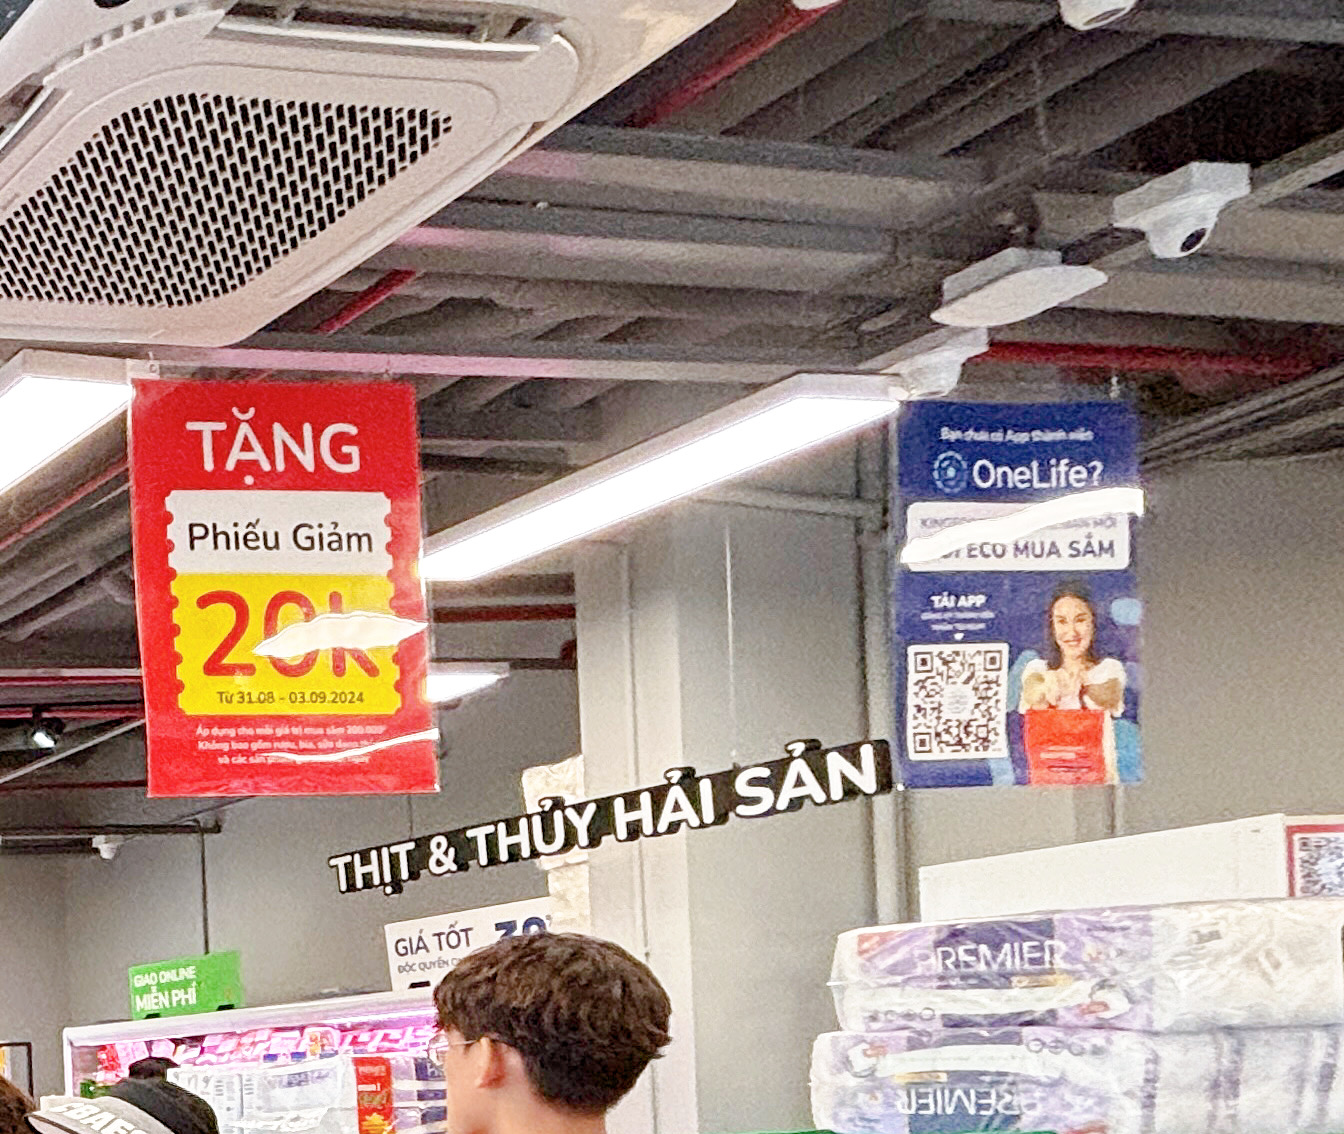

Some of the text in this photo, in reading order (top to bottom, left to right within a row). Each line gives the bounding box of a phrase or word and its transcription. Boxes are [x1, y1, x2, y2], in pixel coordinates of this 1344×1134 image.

[185, 405, 361, 486] TẶNG
[973, 458, 1104, 489] OneLife?
[188, 518, 373, 553] Phiếu Giảm
[966, 532, 1116, 559] ECO MUA SẮM
[957, 594, 987, 607] APP
[236, 690, 274, 705] 31.08
[289, 690, 364, 706] 03.09.2024
[328, 742, 879, 897] THỊT & THỦY HẢI SẢN
[394, 928, 430, 957] GIÁ
[432, 920, 474, 952] TỐT
[915, 940, 1070, 974] PREMIER
[133, 965, 196, 988] GIAO ONLINE
[135, 980, 197, 1013] MIỄN PHÍ
